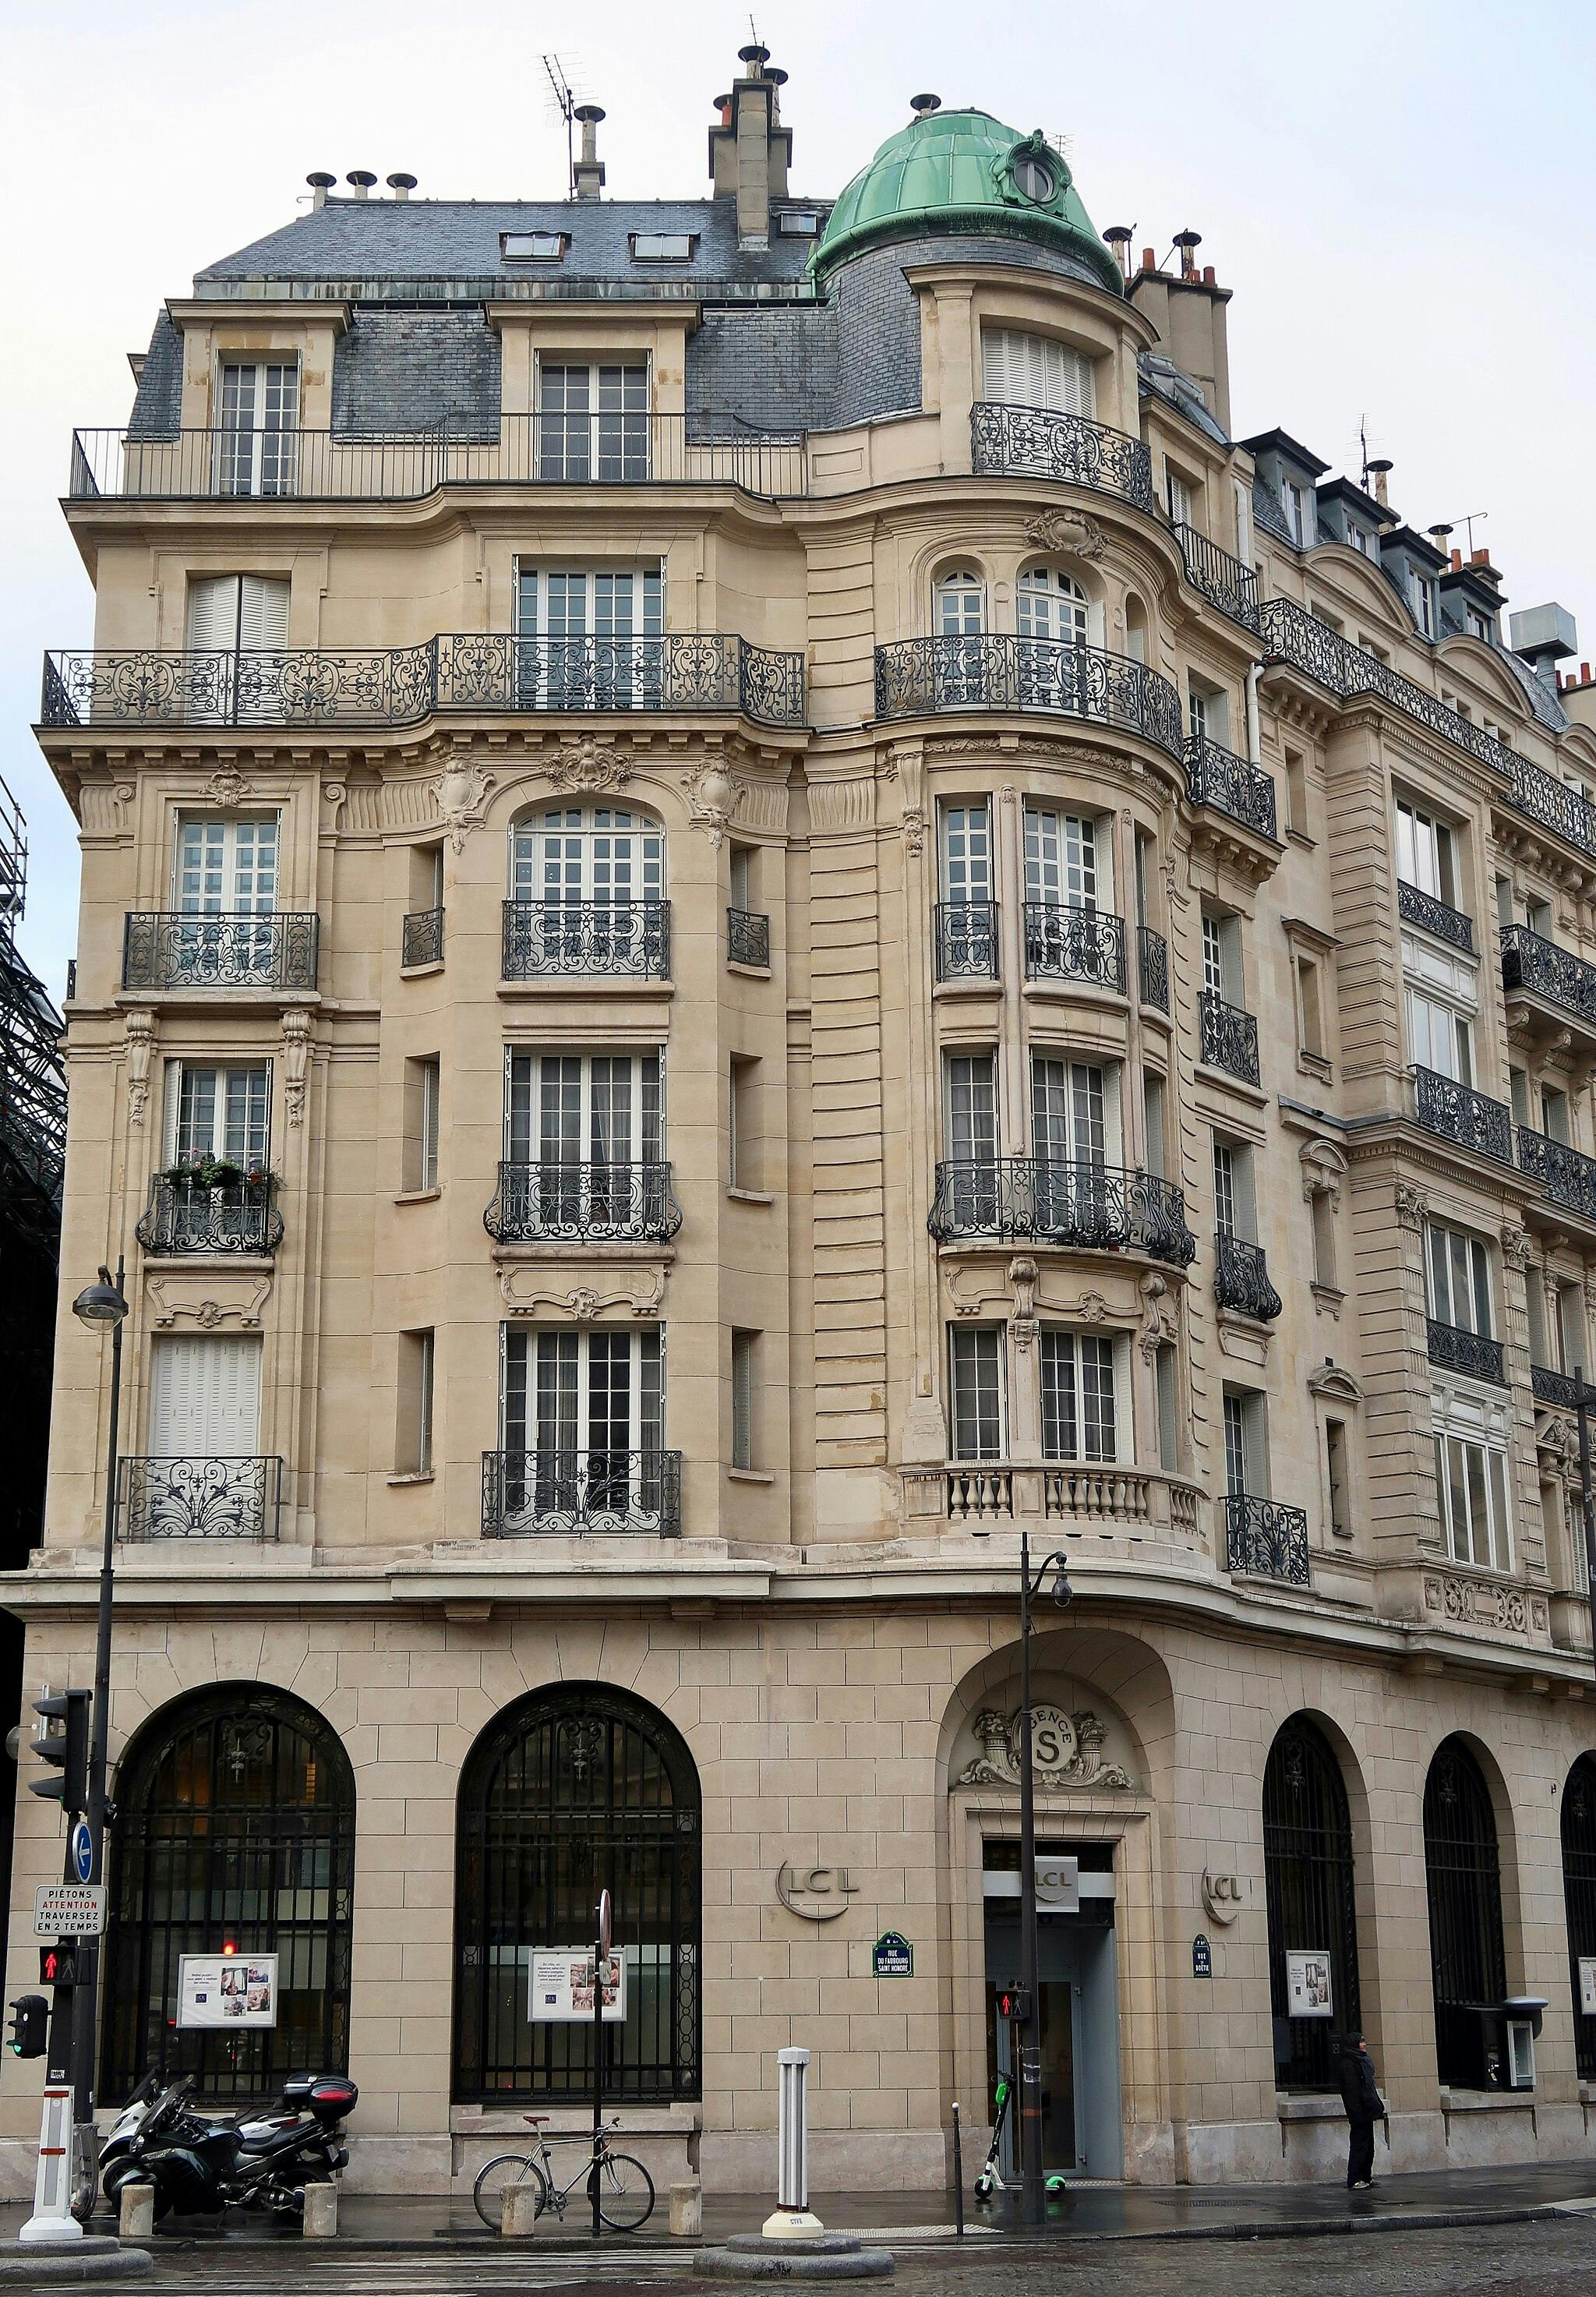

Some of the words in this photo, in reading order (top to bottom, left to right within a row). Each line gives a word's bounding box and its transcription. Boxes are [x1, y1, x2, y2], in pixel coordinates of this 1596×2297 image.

[1030, 1710, 1072, 1744] GENCE
[1036, 1730, 1060, 1763] S
[786, 1868, 860, 1892] LCL
[1035, 1871, 1072, 1886] LCL
[1206, 1875, 1243, 1900] LCL
[48, 1889, 92, 1899] PIÉTONS
